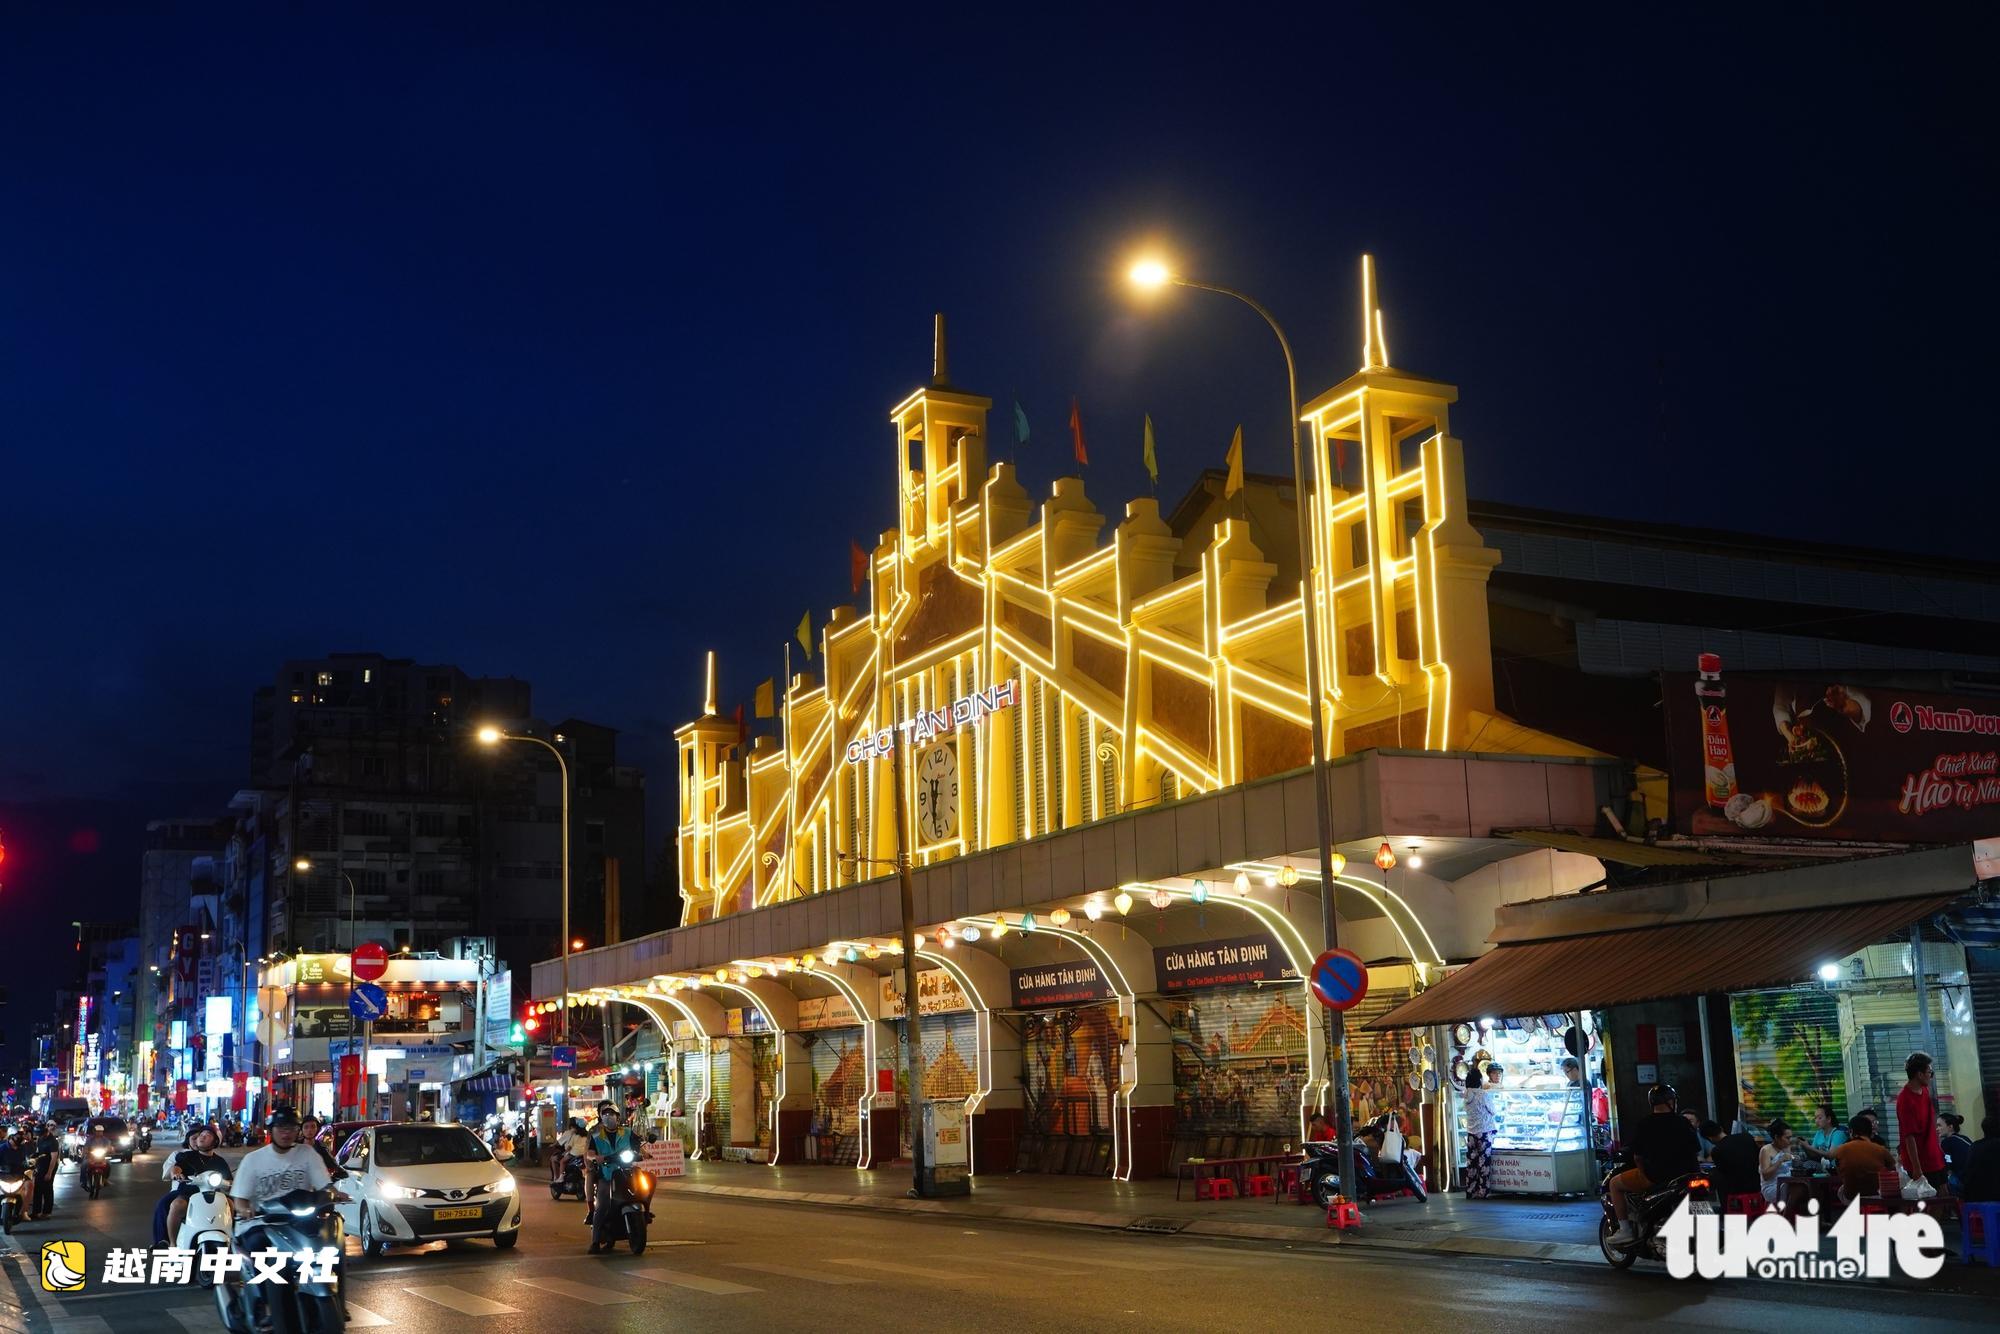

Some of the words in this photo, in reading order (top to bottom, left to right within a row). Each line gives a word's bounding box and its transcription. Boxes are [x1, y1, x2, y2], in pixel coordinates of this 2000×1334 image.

[846, 726, 894, 765] CHỢ
[899, 706, 947, 745] TÂN
[953, 679, 1013, 726] ĐỊNH
[934, 749, 943, 763] 12
[1936, 754, 1967, 774] Chiết
[1968, 753, 1998, 772] Xuất
[920, 792, 927, 806] 9
[952, 783, 958, 797] 3
[1900, 772, 1952, 813] Hào
[1956, 782, 1974, 807] Tự
[1975, 780, 2000, 802] Nhi
[1166, 952, 1186, 971] CỬA
[1187, 950, 1215, 968] HÀNG
[1217, 946, 1238, 965] TÂN
[1241, 944, 1268, 966] ĐỊNH
[1018, 973, 1034, 990] CỬA
[1035, 971, 1056, 987] HÀNG
[1057, 969, 1074, 985] TÂN
[1075, 968, 1096, 986] ĐỊNH
